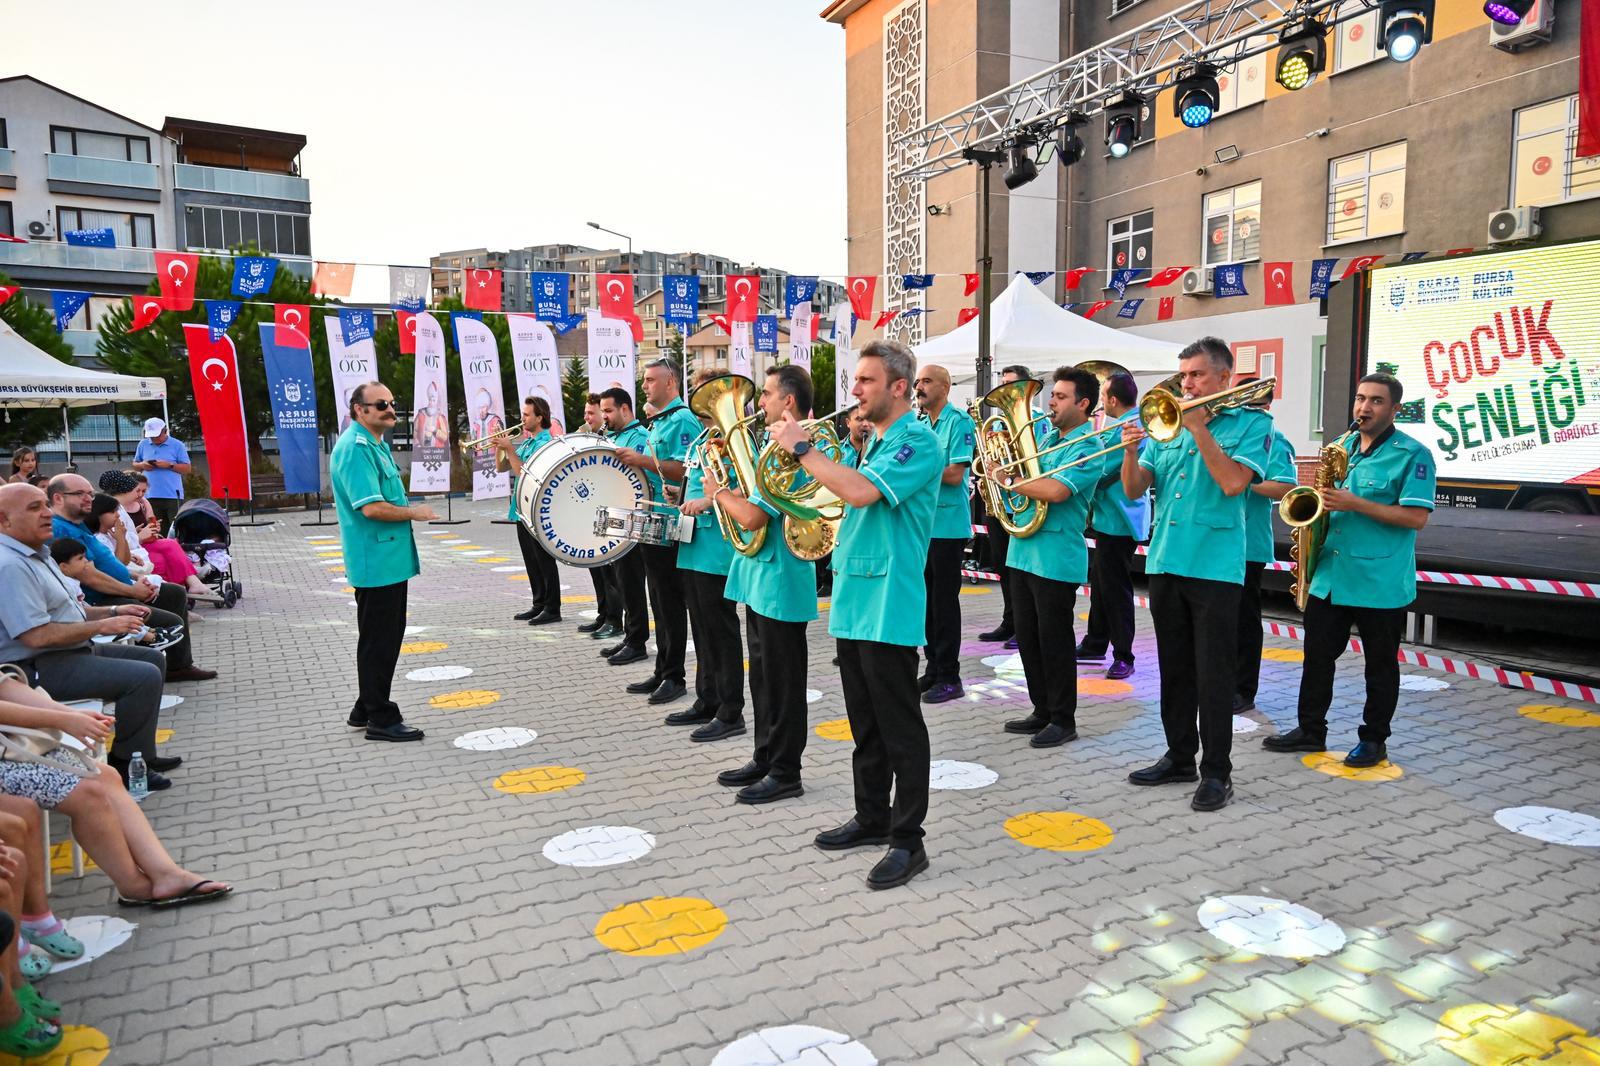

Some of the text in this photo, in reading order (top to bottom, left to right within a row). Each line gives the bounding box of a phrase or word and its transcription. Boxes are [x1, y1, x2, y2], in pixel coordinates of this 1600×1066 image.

[1473, 270, 1514, 284] BURSA
[1472, 284, 1514, 300] KÜLTÜR
[1423, 299, 1566, 399] ÇOCUK
[21, 384, 73, 394] BÜYÜKŞEHİR
[76, 384, 119, 394] BELEDİYESİ
[1432, 359, 1586, 461] ŞENLİĞİ
[1554, 423, 1599, 443] GÖRÜKLE
[540, 455, 645, 558] BURSA METROPOLITIAN MUNICIPAL
[1455, 495, 1477, 503] BURSA
